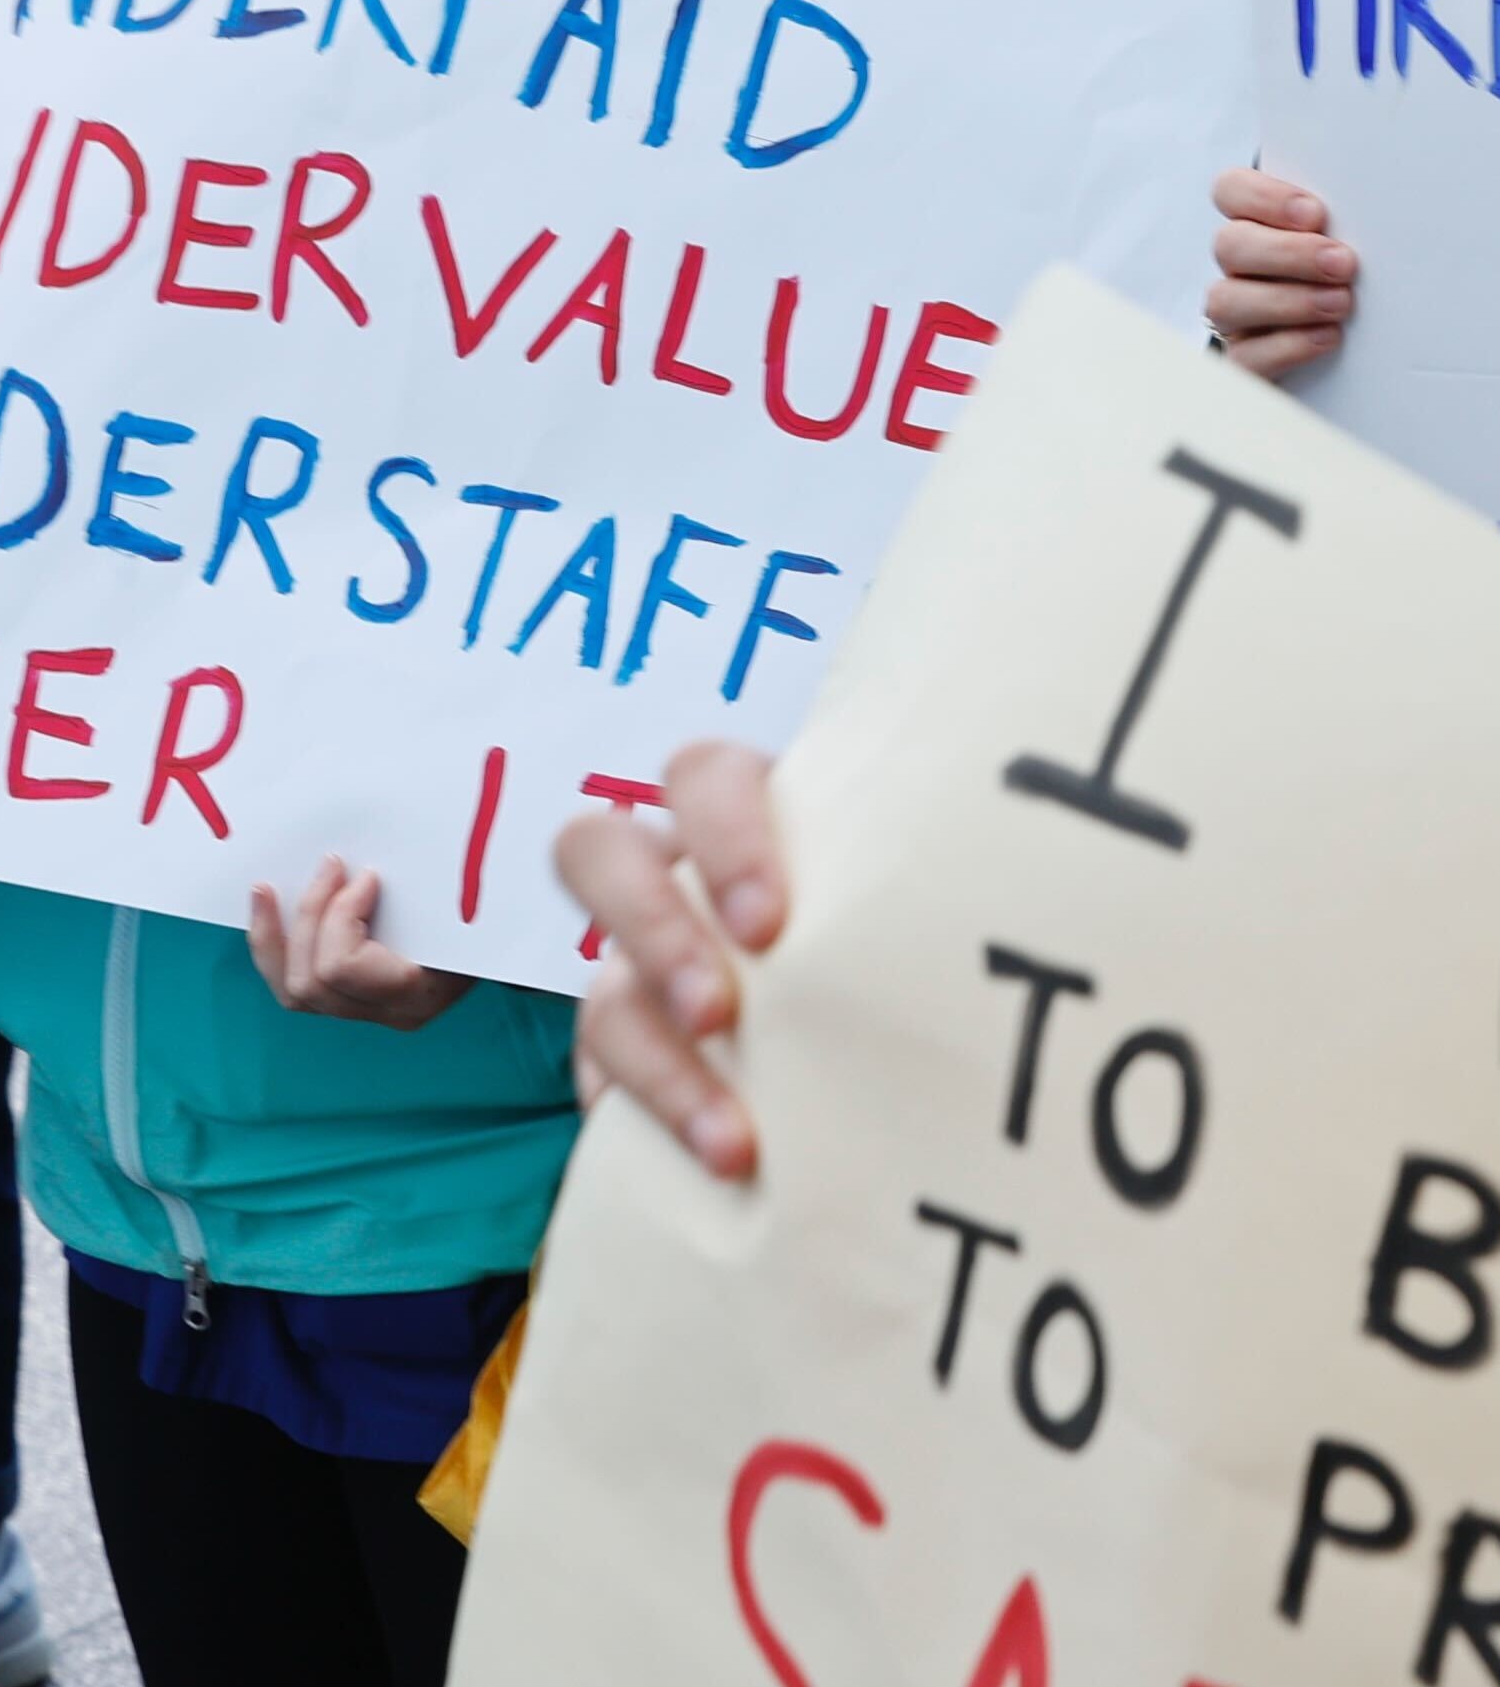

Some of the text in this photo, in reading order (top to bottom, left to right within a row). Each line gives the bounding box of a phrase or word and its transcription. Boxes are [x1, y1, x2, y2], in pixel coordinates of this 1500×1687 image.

[1004, 450, 1302, 852] I
[984, 944, 1207, 1211] TO
[914, 1200, 1110, 1454] TO
